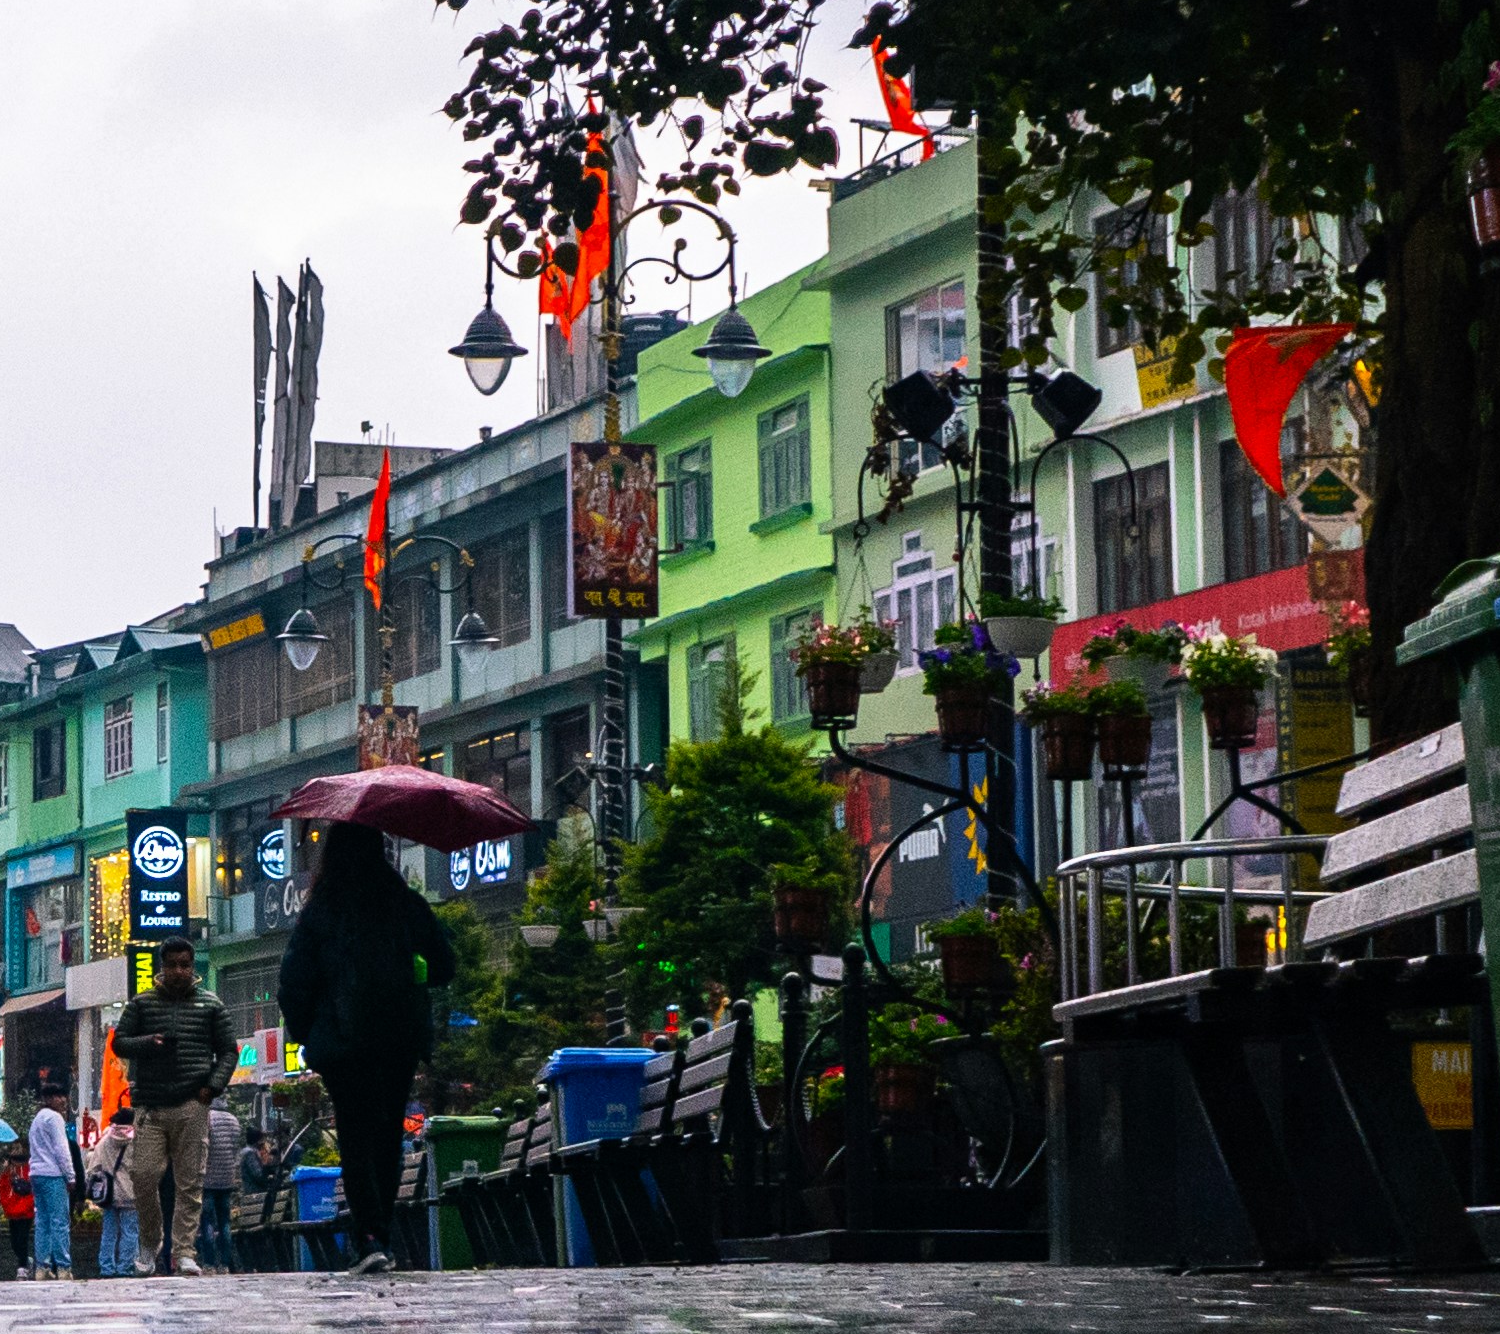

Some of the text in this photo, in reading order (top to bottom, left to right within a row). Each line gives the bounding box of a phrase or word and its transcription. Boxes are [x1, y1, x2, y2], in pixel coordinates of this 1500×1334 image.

[475, 839, 513, 876] Osm
[899, 828, 940, 863] PUMA
[140, 889, 182, 903] RESTRO
[140, 915, 183, 928] LOUNGE
